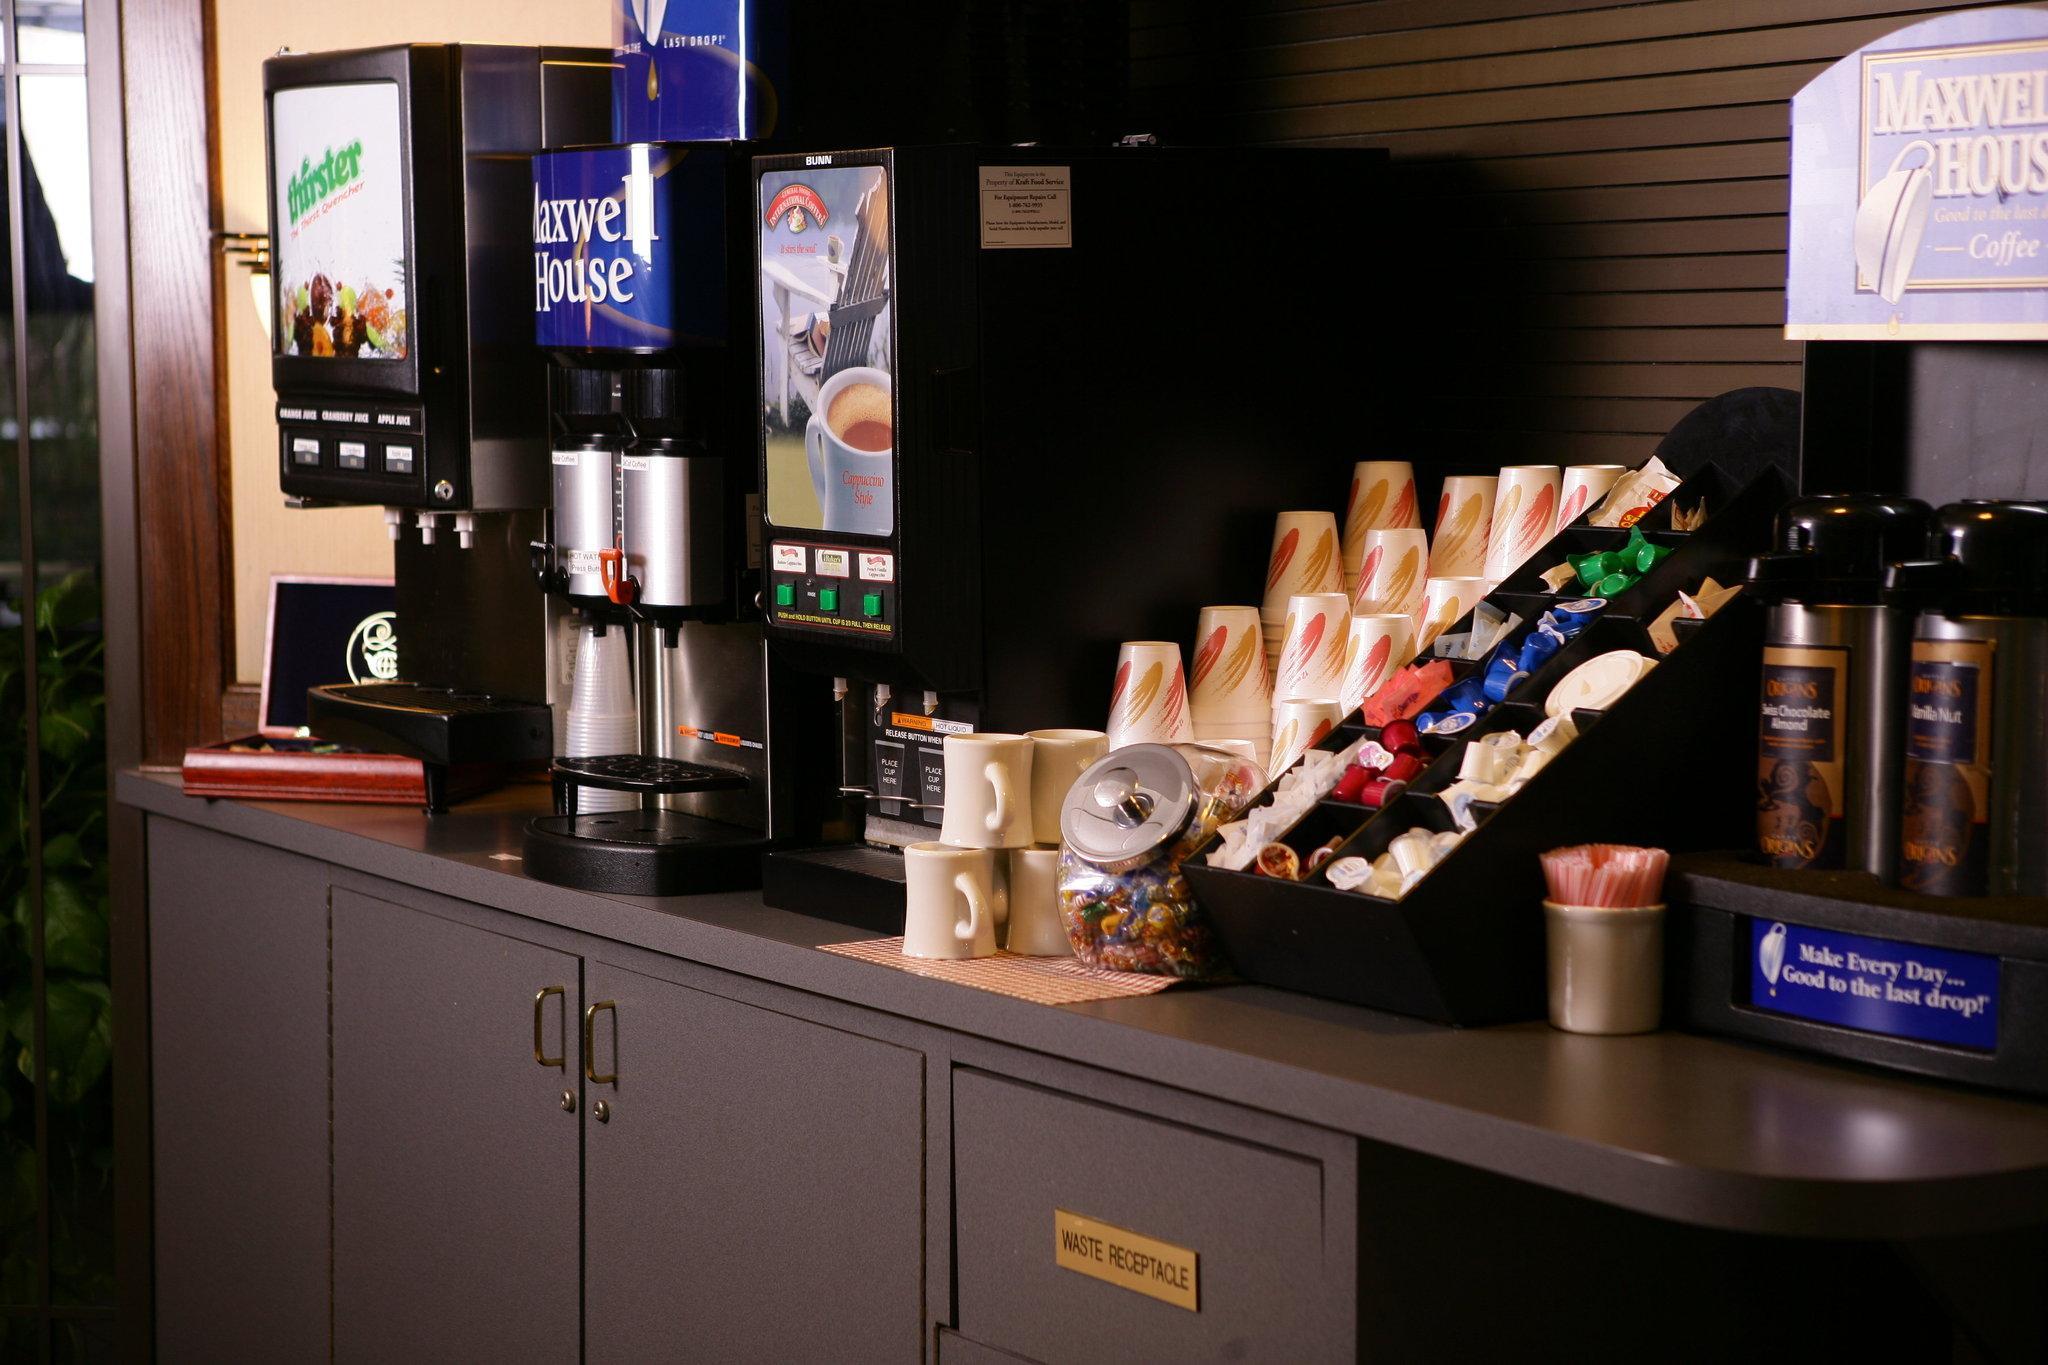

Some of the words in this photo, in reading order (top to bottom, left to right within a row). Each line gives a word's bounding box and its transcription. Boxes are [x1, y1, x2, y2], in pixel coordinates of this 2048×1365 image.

[664, 37, 685, 49] LAST
[806, 155, 832, 166] BUNN
[1990, 204, 2011, 220] the
[1968, 231, 2039, 265] Coffee
[534, 251, 634, 312] House
[280, 407, 302, 419] ORANGE
[303, 408, 317, 420] JUICE
[322, 410, 353, 422] CRANBERRY
[354, 412, 369, 423] JUICE
[377, 413, 395, 425] APPLE
[396, 415, 411, 426] JUICE
[843, 471, 884, 491] Cappuccino
[855, 490, 873, 509] Style
[1779, 704, 1831, 720] Chocolate
[936, 722, 947, 731] HOT
[1771, 716, 1808, 731] Almond
[886, 729, 907, 739] RELEASE
[908, 733, 926, 742] BUTTON
[928, 736, 942, 744] WHEN
[882, 759, 898, 768] PLACE
[885, 767, 896, 776] CUP
[926, 767, 942, 776] PLACE
[883, 777, 897, 785] HERE
[928, 775, 940, 784] CUP
[927, 785, 941, 793] HERE
[1798, 943, 1844, 970] Make
[1846, 951, 1902, 983] Every
[1782, 964, 1827, 991] Good
[1829, 975, 1848, 994] to
[1850, 977, 1882, 999] the
[1886, 983, 1921, 1006] last
[1061, 1230, 1103, 1262] WASTE
[1109, 1245, 1189, 1290] RECEPTACLE
